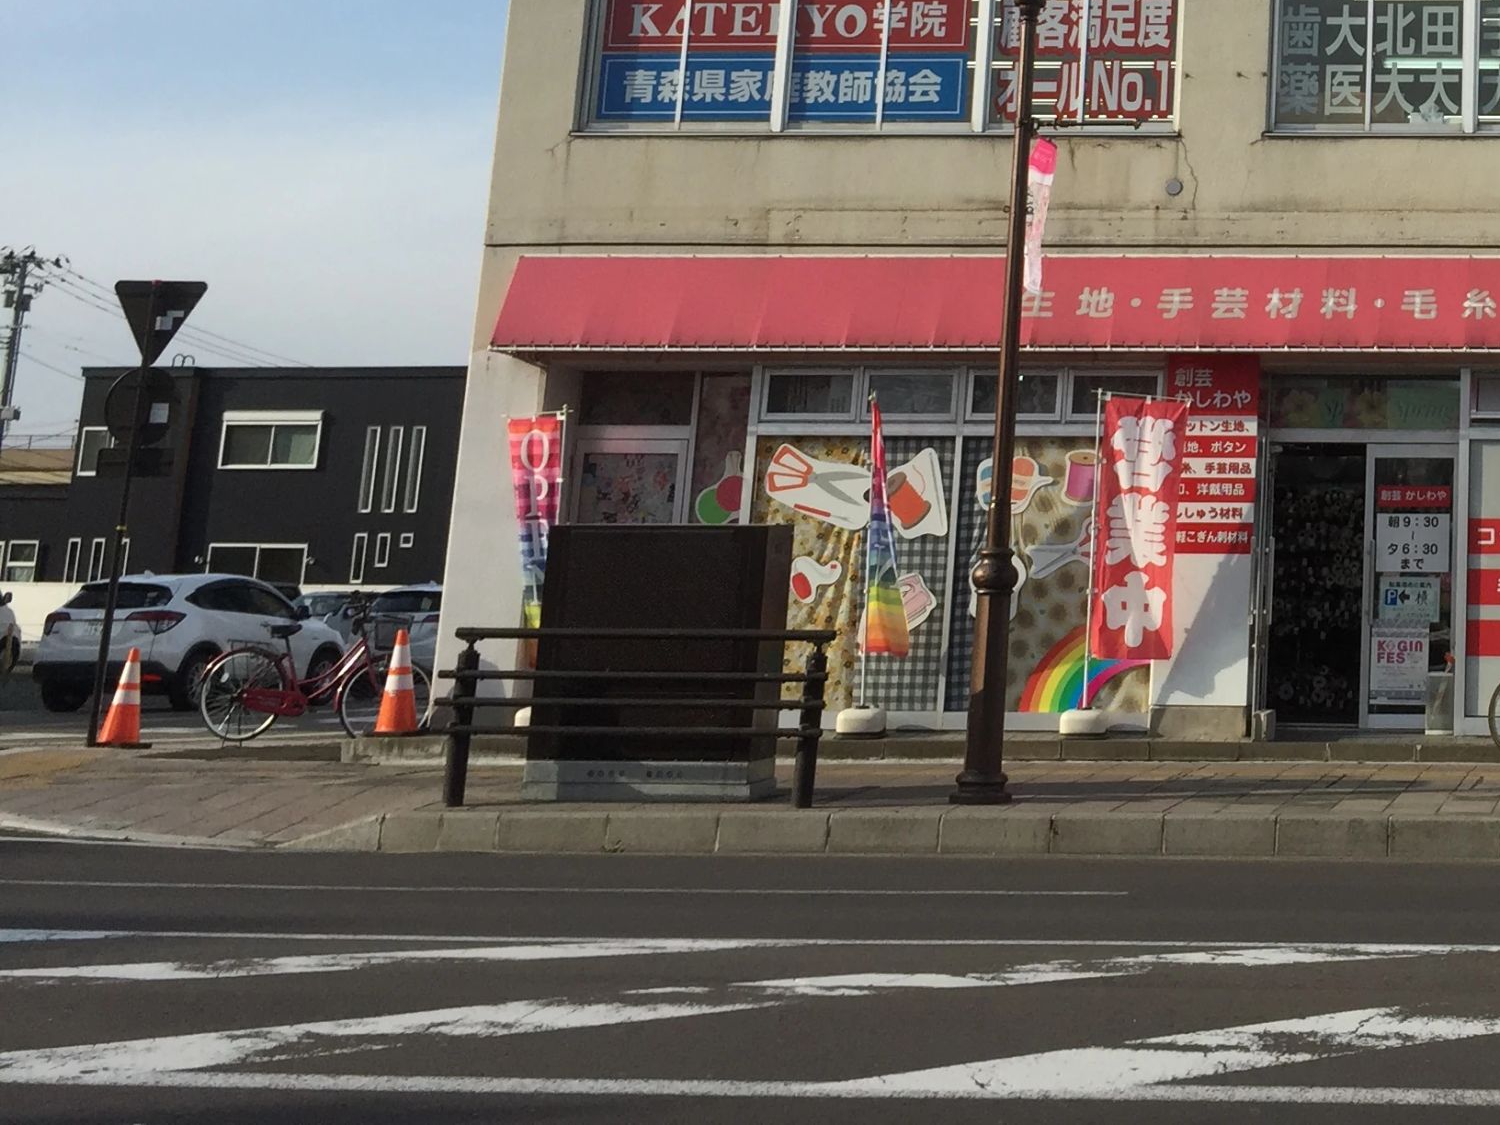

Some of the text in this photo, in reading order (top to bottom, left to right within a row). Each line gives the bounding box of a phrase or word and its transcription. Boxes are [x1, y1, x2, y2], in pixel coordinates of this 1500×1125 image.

[1175, 368, 1213, 387] 創芸
[1175, 390, 1251, 409] かしわや
[1185, 421, 1251, 433] ットン生地、
[1183, 441, 1247, 454] 地、ボタン
[1101, 416, 1176, 648] 営業中
[1176, 530, 1249, 544] 軽こぎん刺材料
[1400, 557, 1425, 570] まで
[1377, 651, 1407, 664] FES
